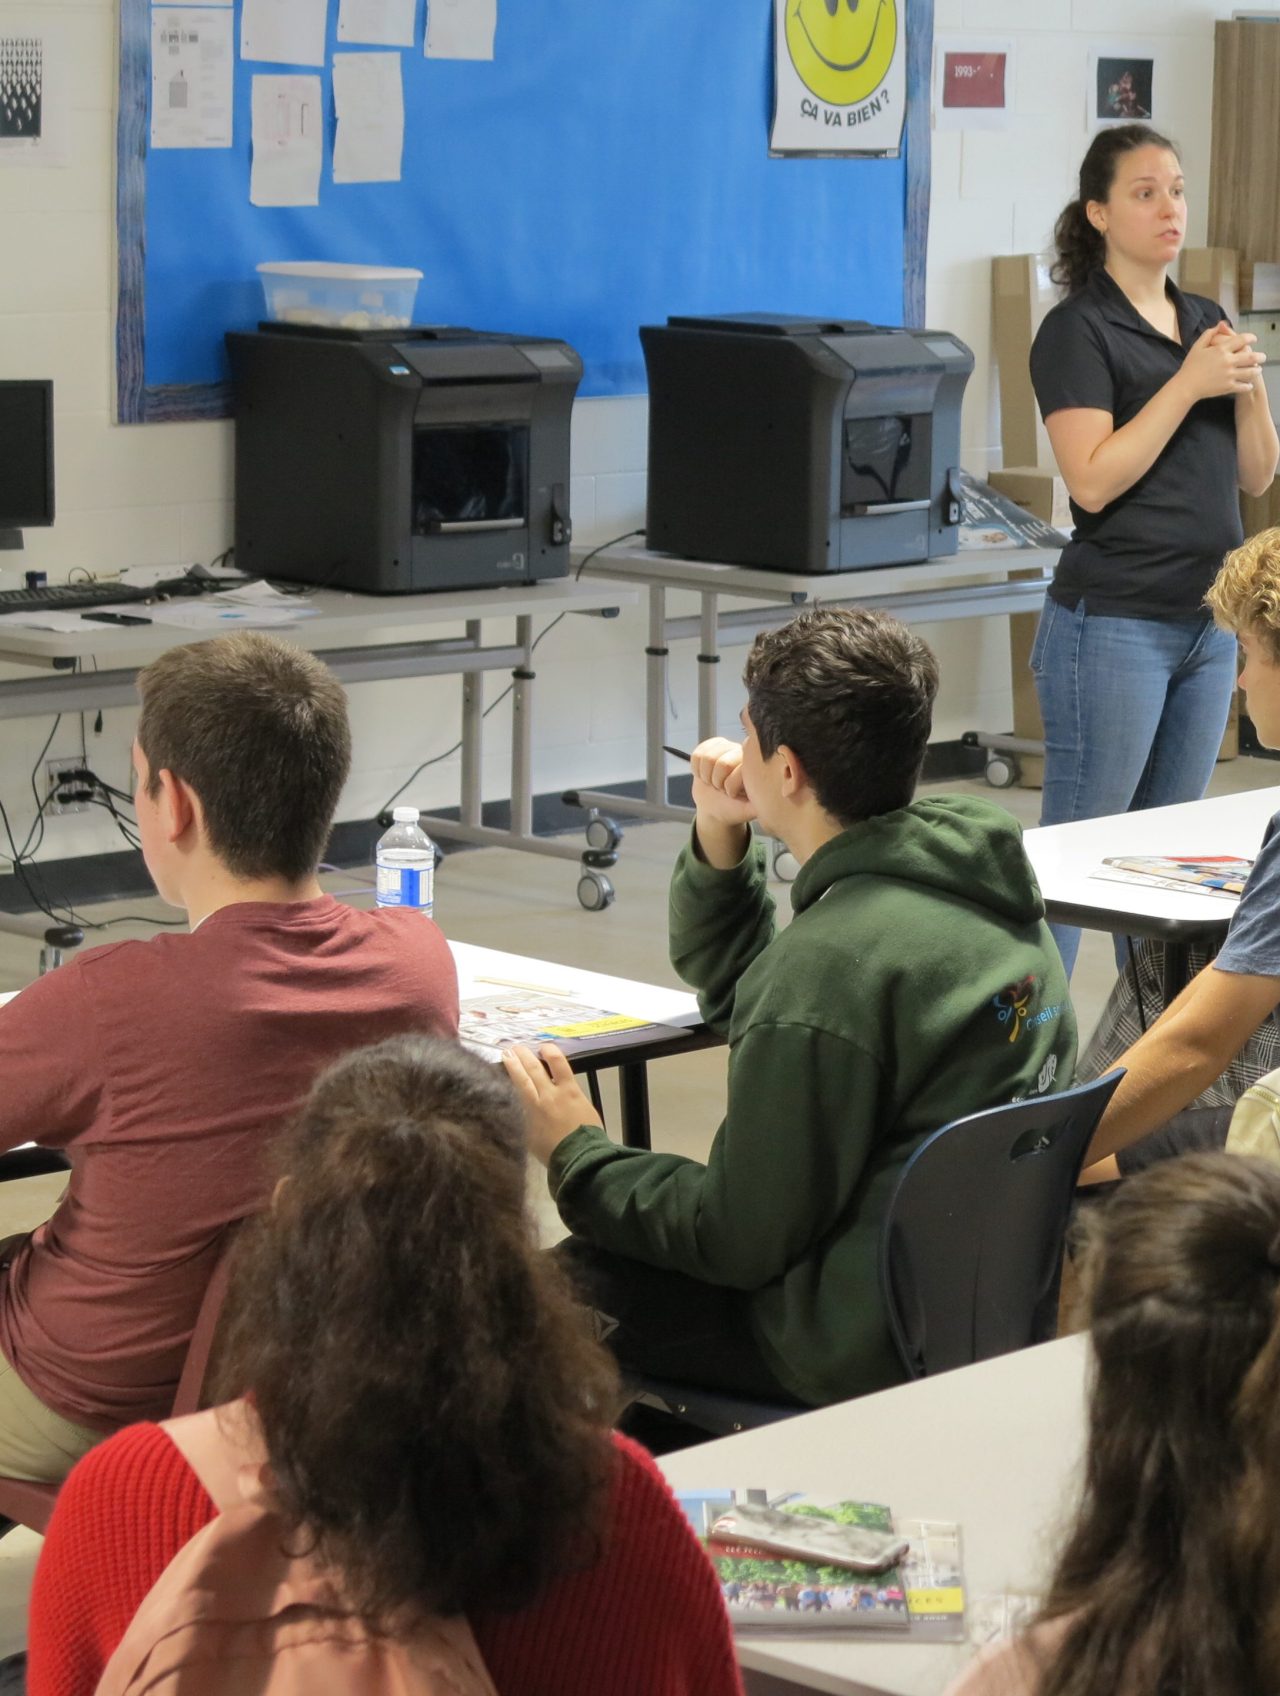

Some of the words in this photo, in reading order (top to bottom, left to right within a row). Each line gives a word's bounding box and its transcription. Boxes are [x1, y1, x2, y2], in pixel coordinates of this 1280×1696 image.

[801, 98, 818, 120] ÇA
[824, 109, 842, 126] VA
[1026, 1006, 1053, 1031] Cseil
